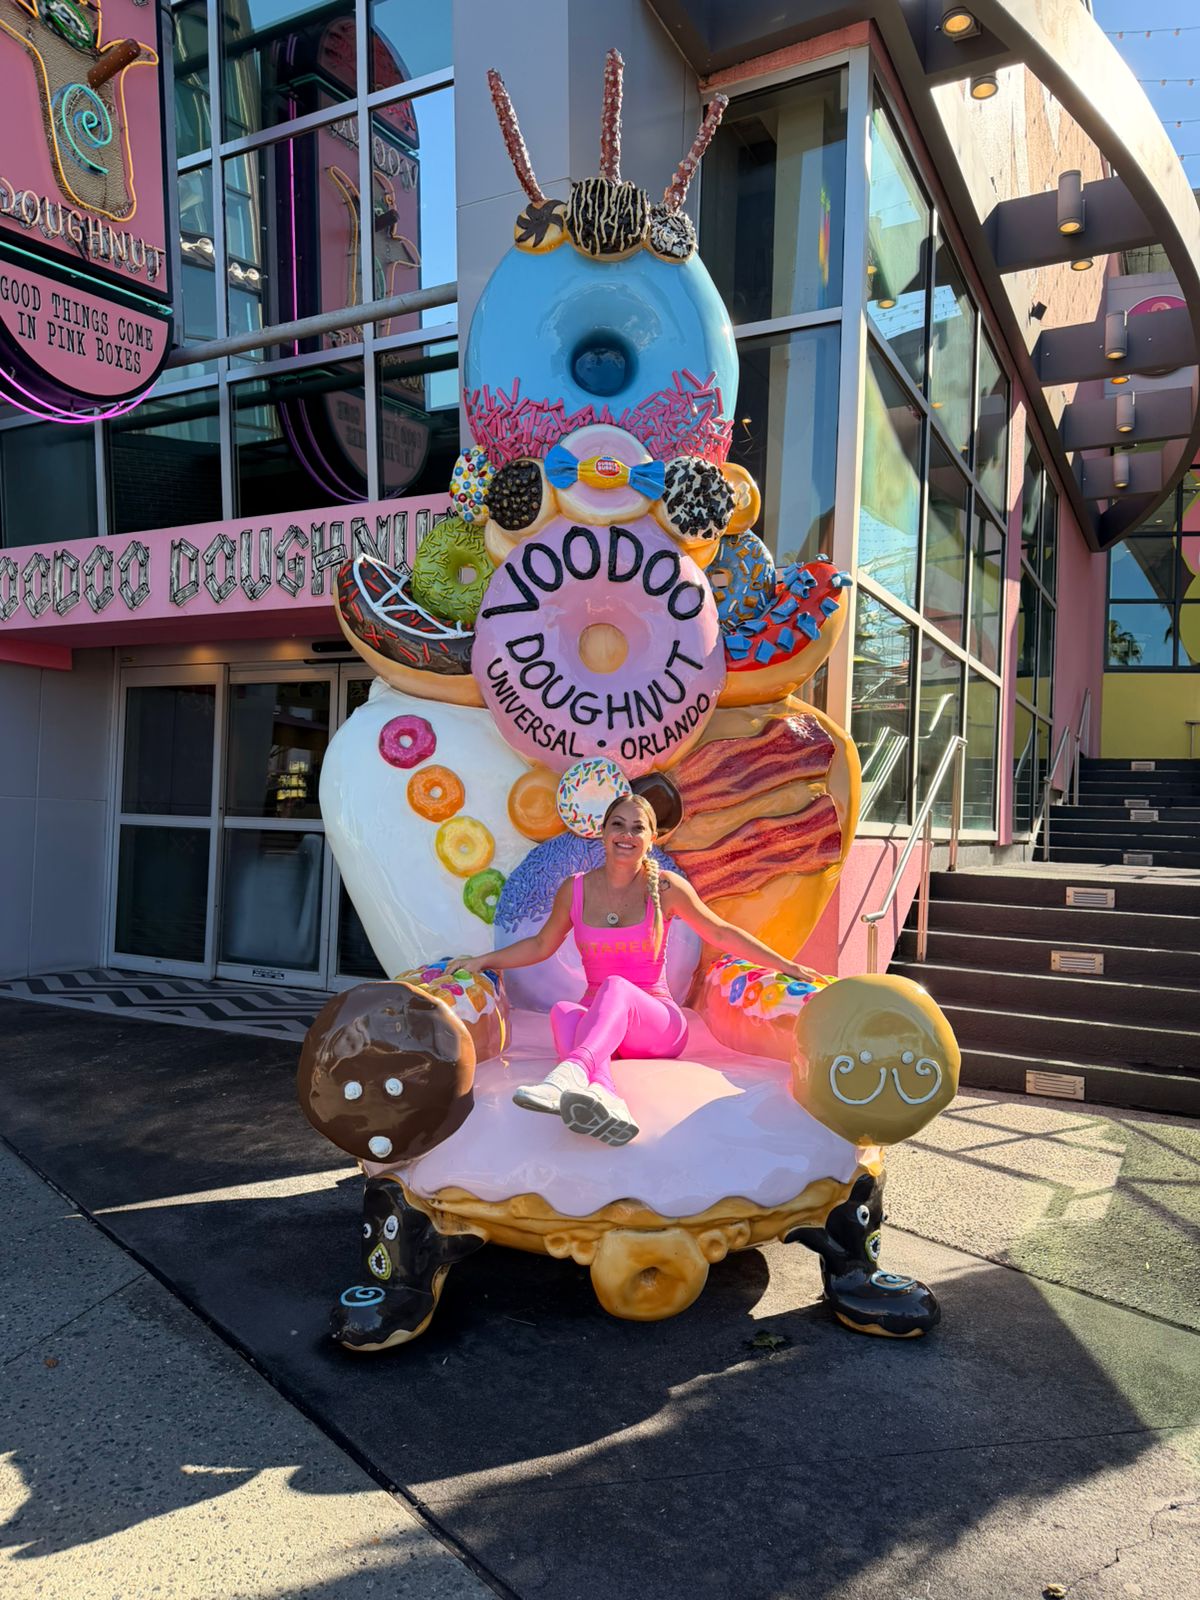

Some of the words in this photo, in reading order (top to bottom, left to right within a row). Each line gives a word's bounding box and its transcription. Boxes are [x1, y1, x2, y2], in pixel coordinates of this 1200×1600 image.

[1, 276, 41, 311] GOOD
[52, 293, 109, 336] THINGS
[118, 318, 153, 351] COME
[18, 312, 36, 340] IN
[47, 321, 86, 356] PINK
[96, 338, 141, 374] BOXES
[482, 526, 705, 620] VOODOO
[487, 657, 584, 757] UNIVERSAL
[620, 693, 710, 759] ORLANDO
[506, 633, 704, 729] DOUGHNUT
